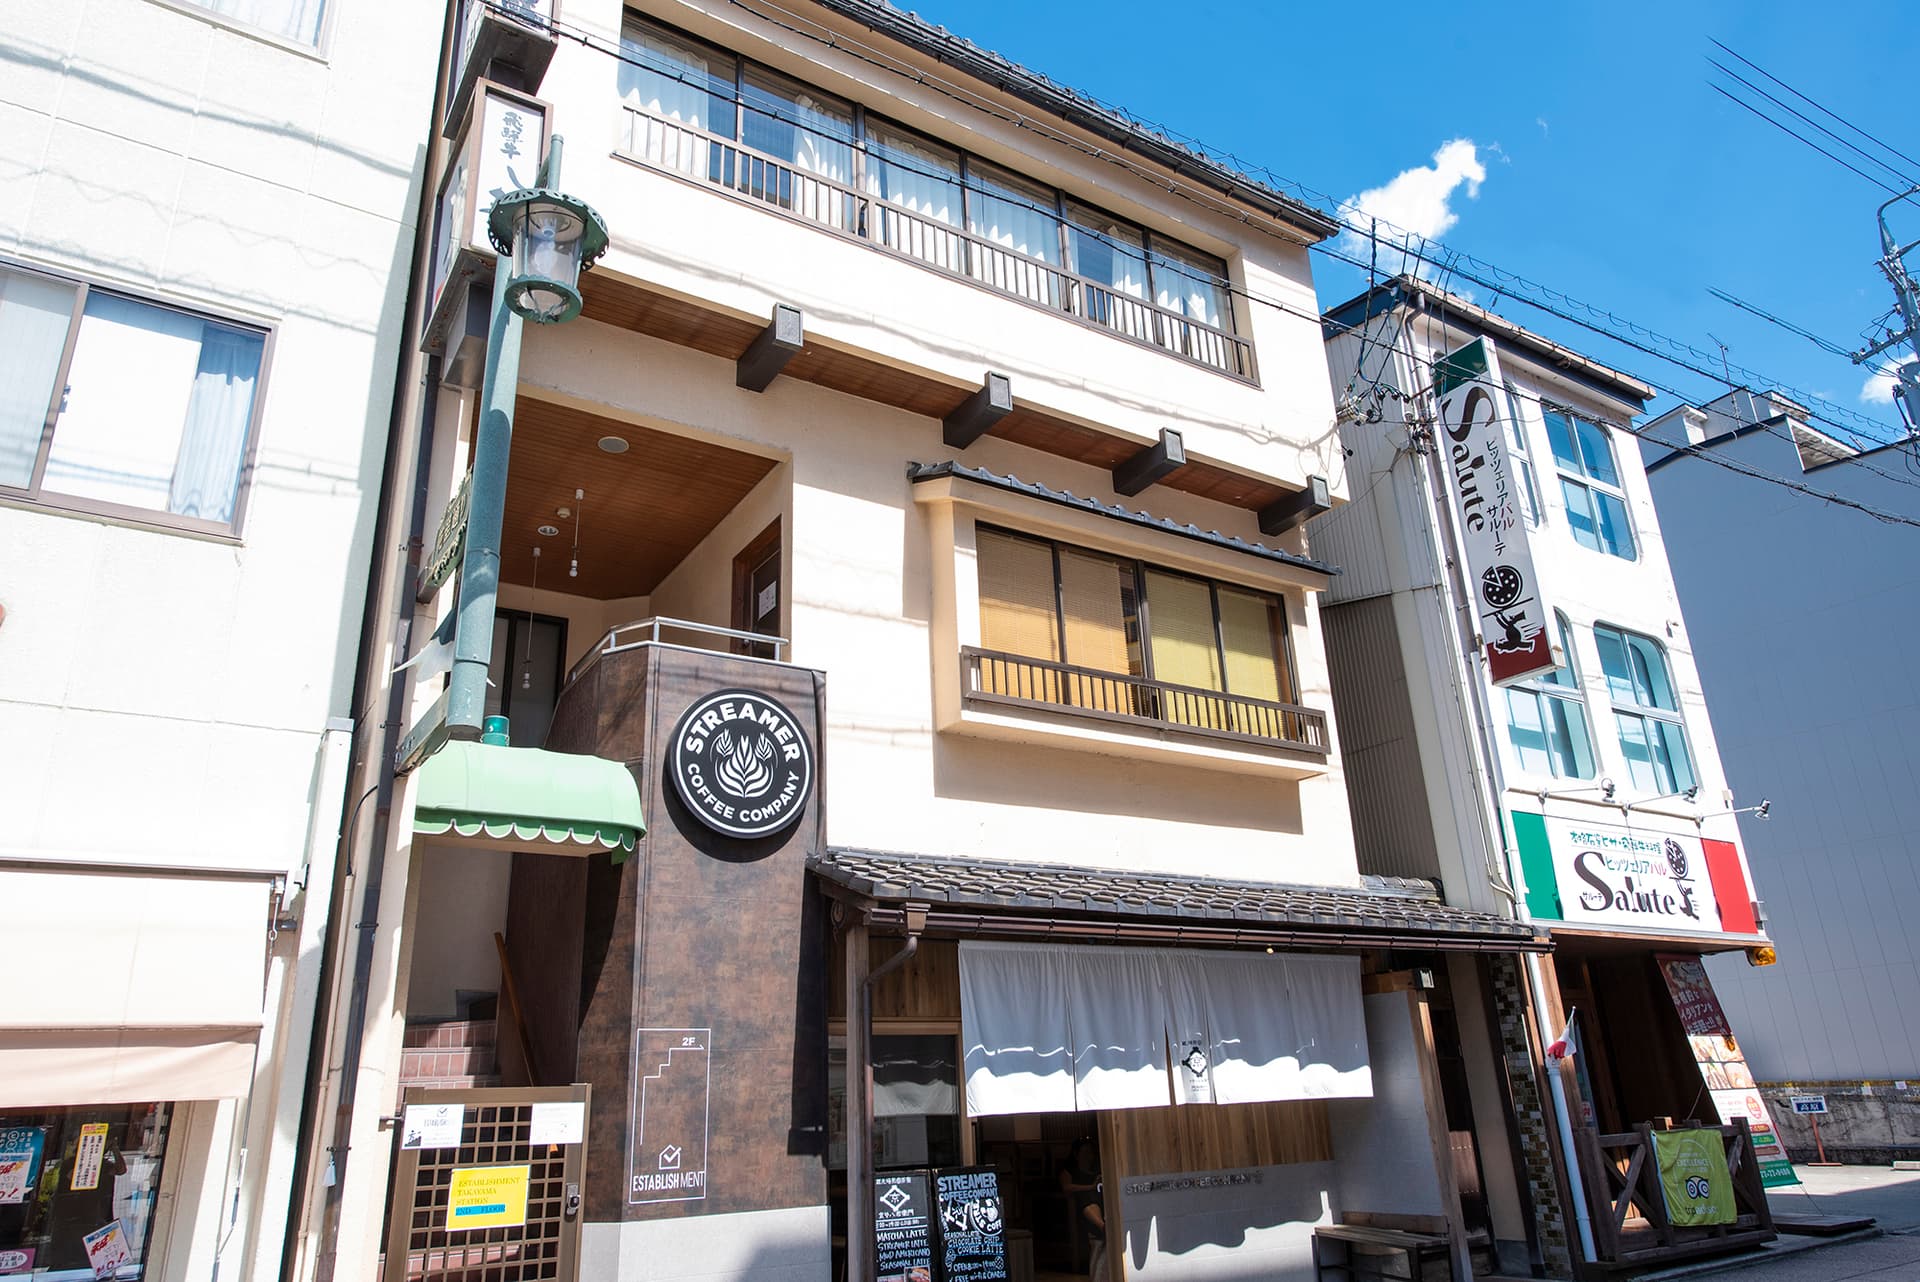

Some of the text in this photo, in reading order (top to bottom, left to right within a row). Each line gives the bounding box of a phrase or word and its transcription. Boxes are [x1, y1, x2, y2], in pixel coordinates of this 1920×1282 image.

[1440, 385, 1497, 536] Salute
[1486, 505, 1507, 557] サルーテ
[685, 702, 800, 763] STREAMER
[687, 763, 800, 823] COFFEE COMPANY
[1574, 851, 1677, 915] Salute
[681, 1037, 696, 1046] 2F
[937, 1172, 997, 1191] STREAMER
[906, 1229, 928, 1238] LATTE
[982, 1244, 1004, 1254] LATTE
